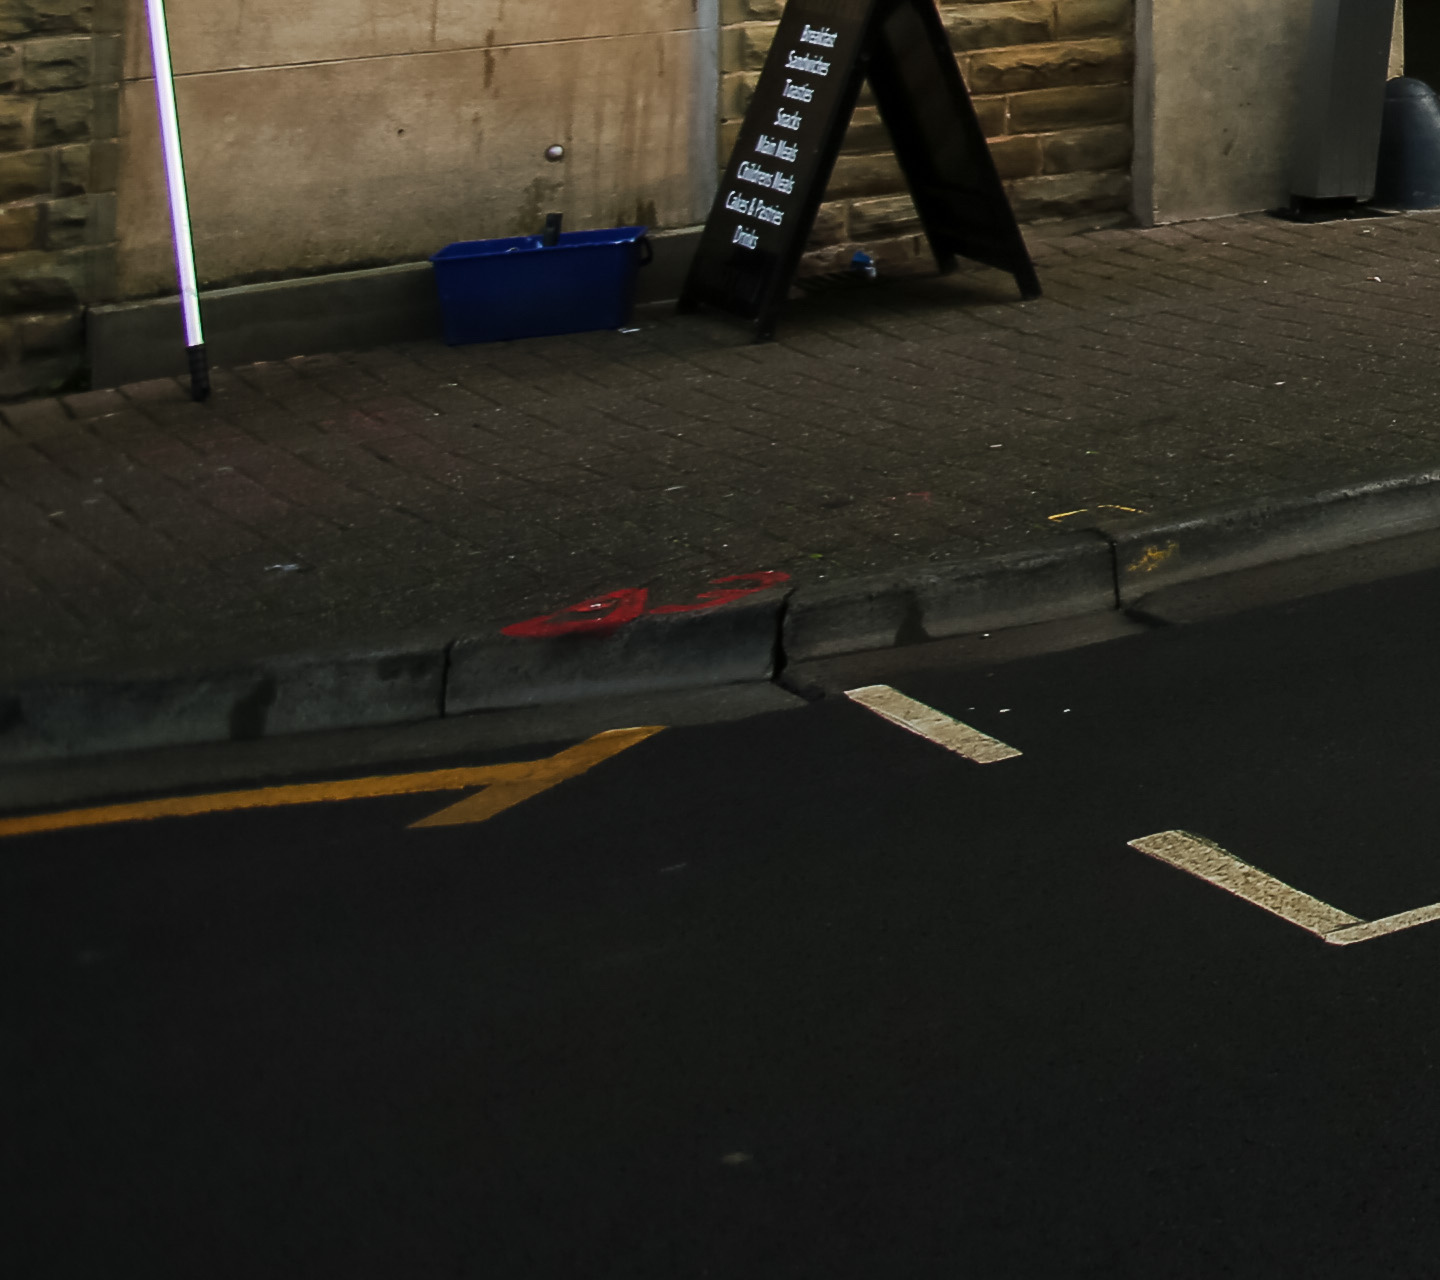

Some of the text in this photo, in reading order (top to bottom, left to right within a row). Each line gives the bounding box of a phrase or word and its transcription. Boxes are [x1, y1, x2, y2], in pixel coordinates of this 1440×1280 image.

[800, 24, 838, 47] Breakfast
[785, 50, 830, 76] Sandwiches
[783, 78, 814, 103] Toasties
[774, 107, 802, 130] Snacks
[755, 135, 798, 162] Main Meals
[772, 171, 795, 194] Meals
[726, 190, 749, 213] Cakes
[755, 199, 784, 226] Pastries
[732, 225, 759, 249] Drinks
